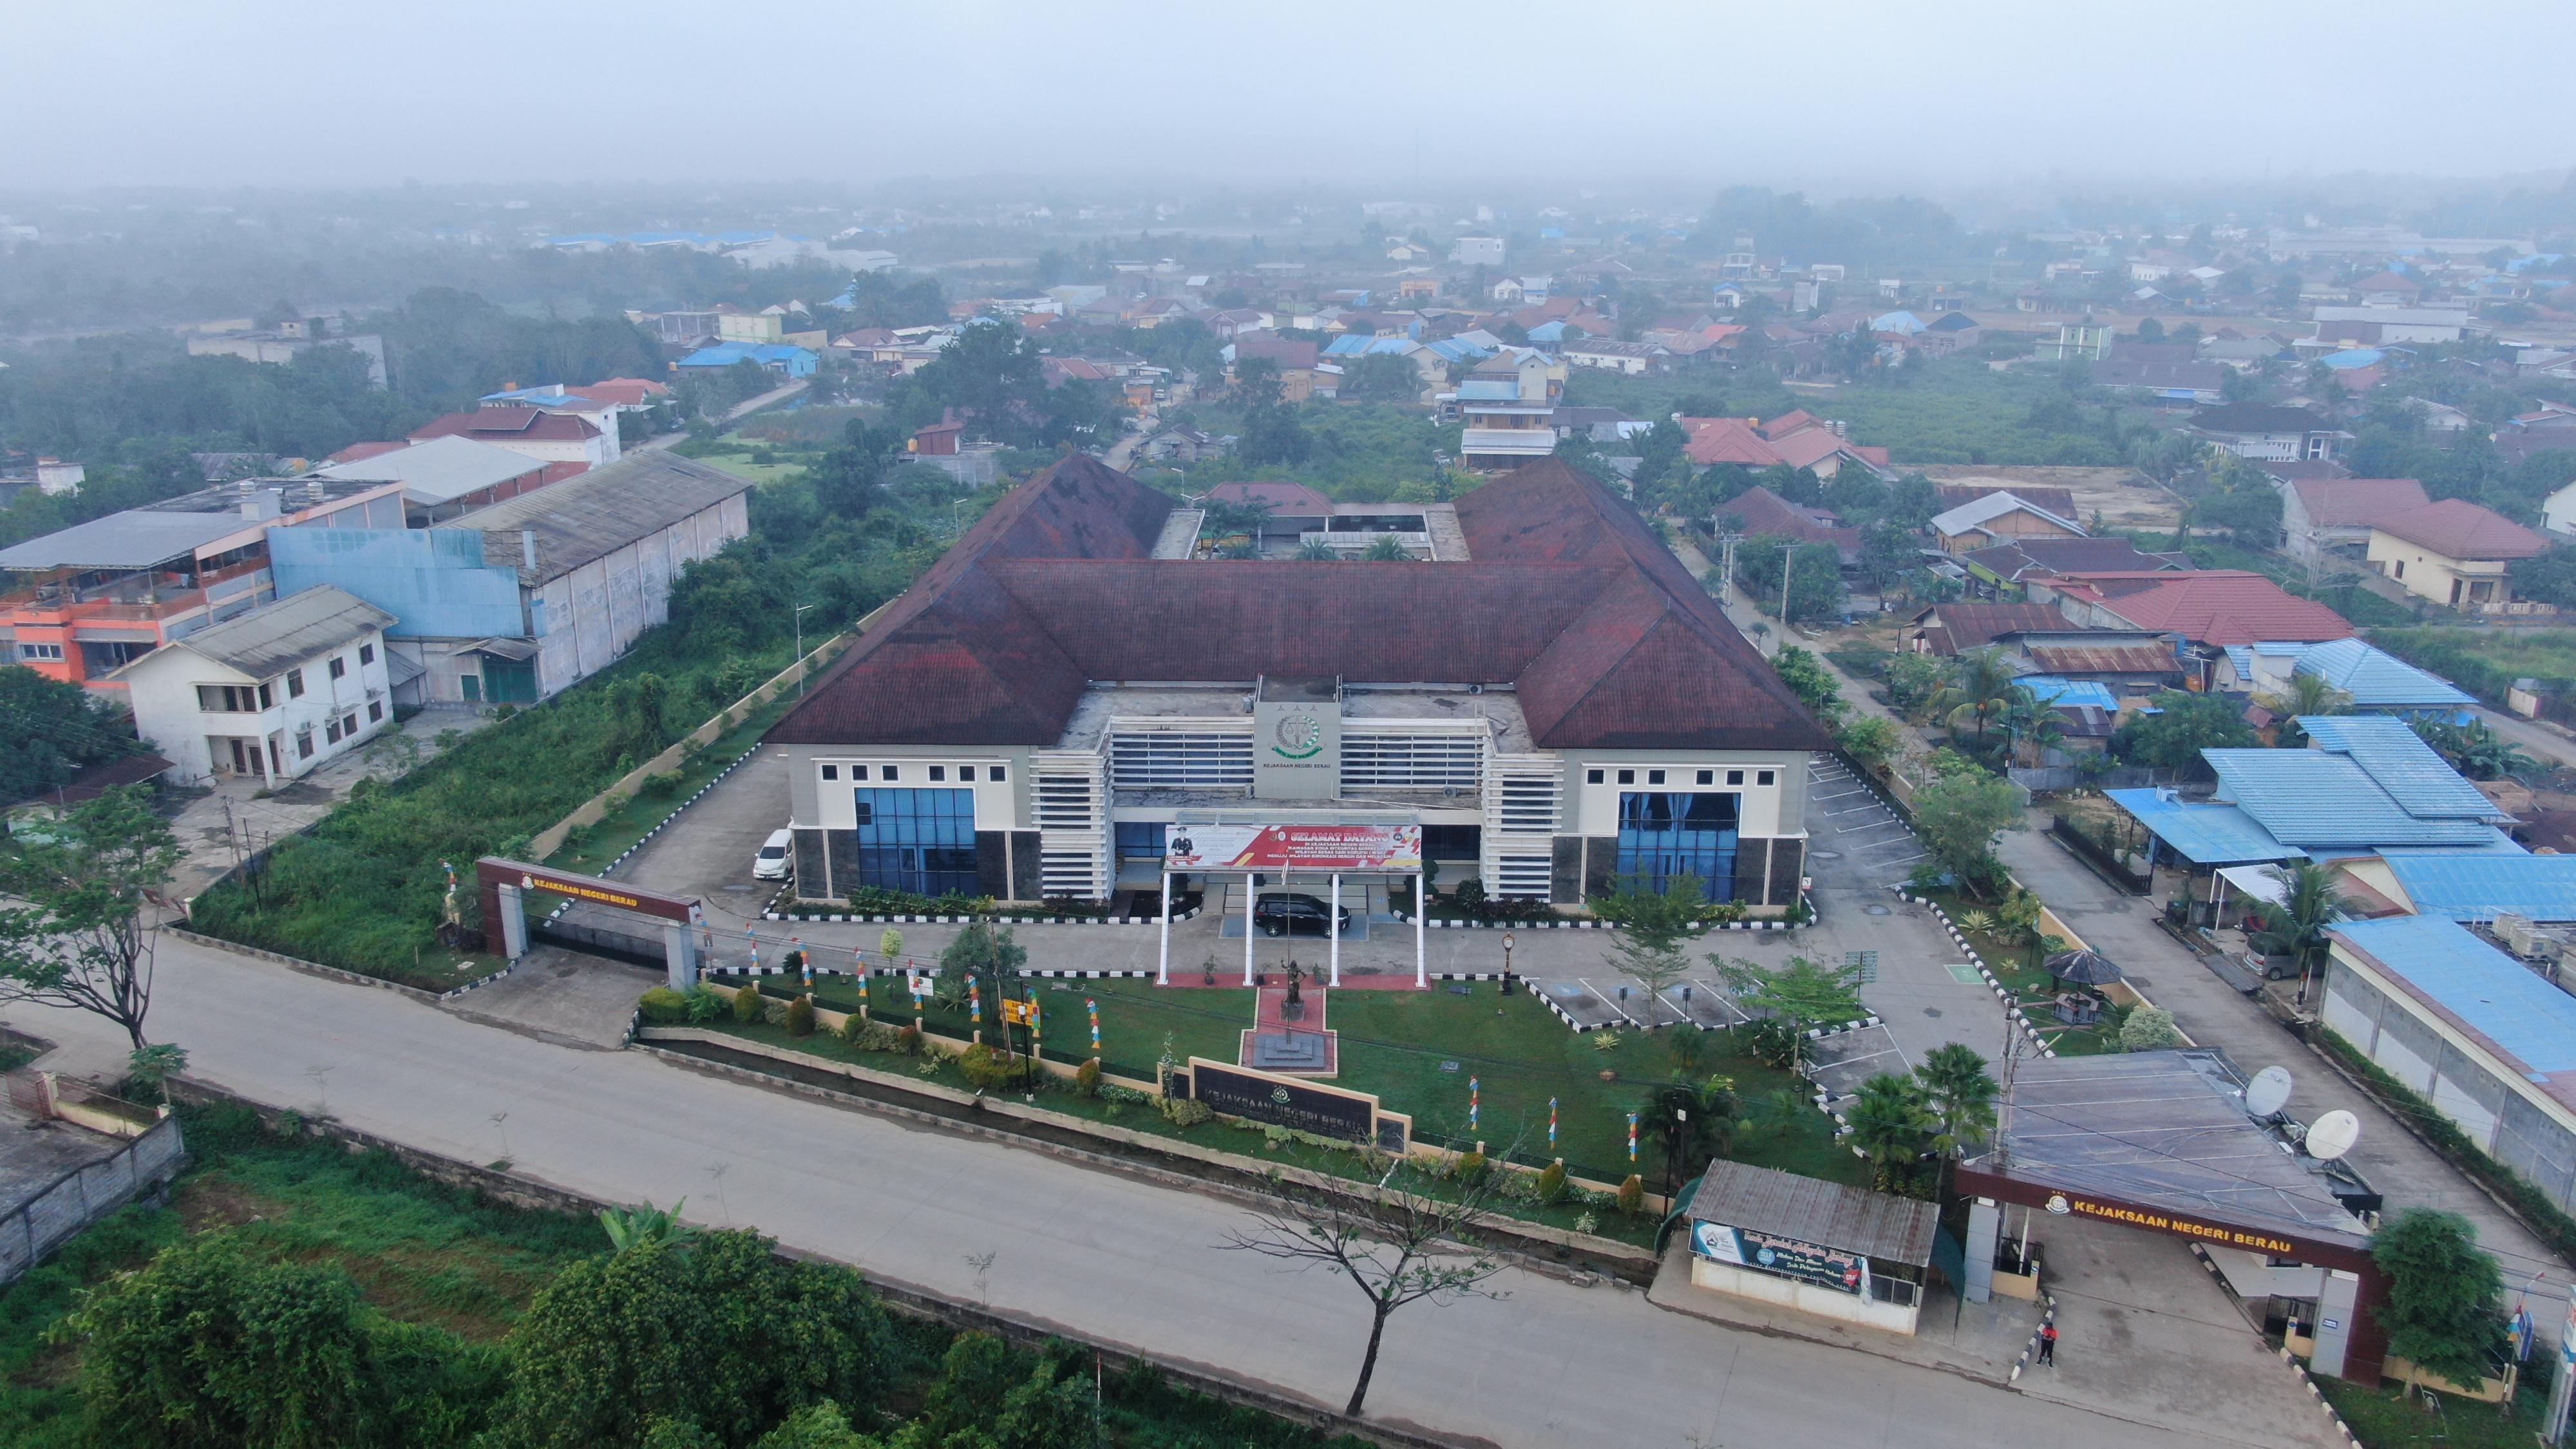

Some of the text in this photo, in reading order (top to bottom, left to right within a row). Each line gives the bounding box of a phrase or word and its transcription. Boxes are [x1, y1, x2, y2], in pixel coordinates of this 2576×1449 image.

[1291, 832, 1389, 842] SELAMAT DATANG
[534, 879, 637, 907] KEJAKSAAN NEGERI BERAU
[1205, 1088, 1272, 1113] KEJAKSAAN
[2074, 1200, 2291, 1252] KEJAKSAAN NEGERI BERAU
